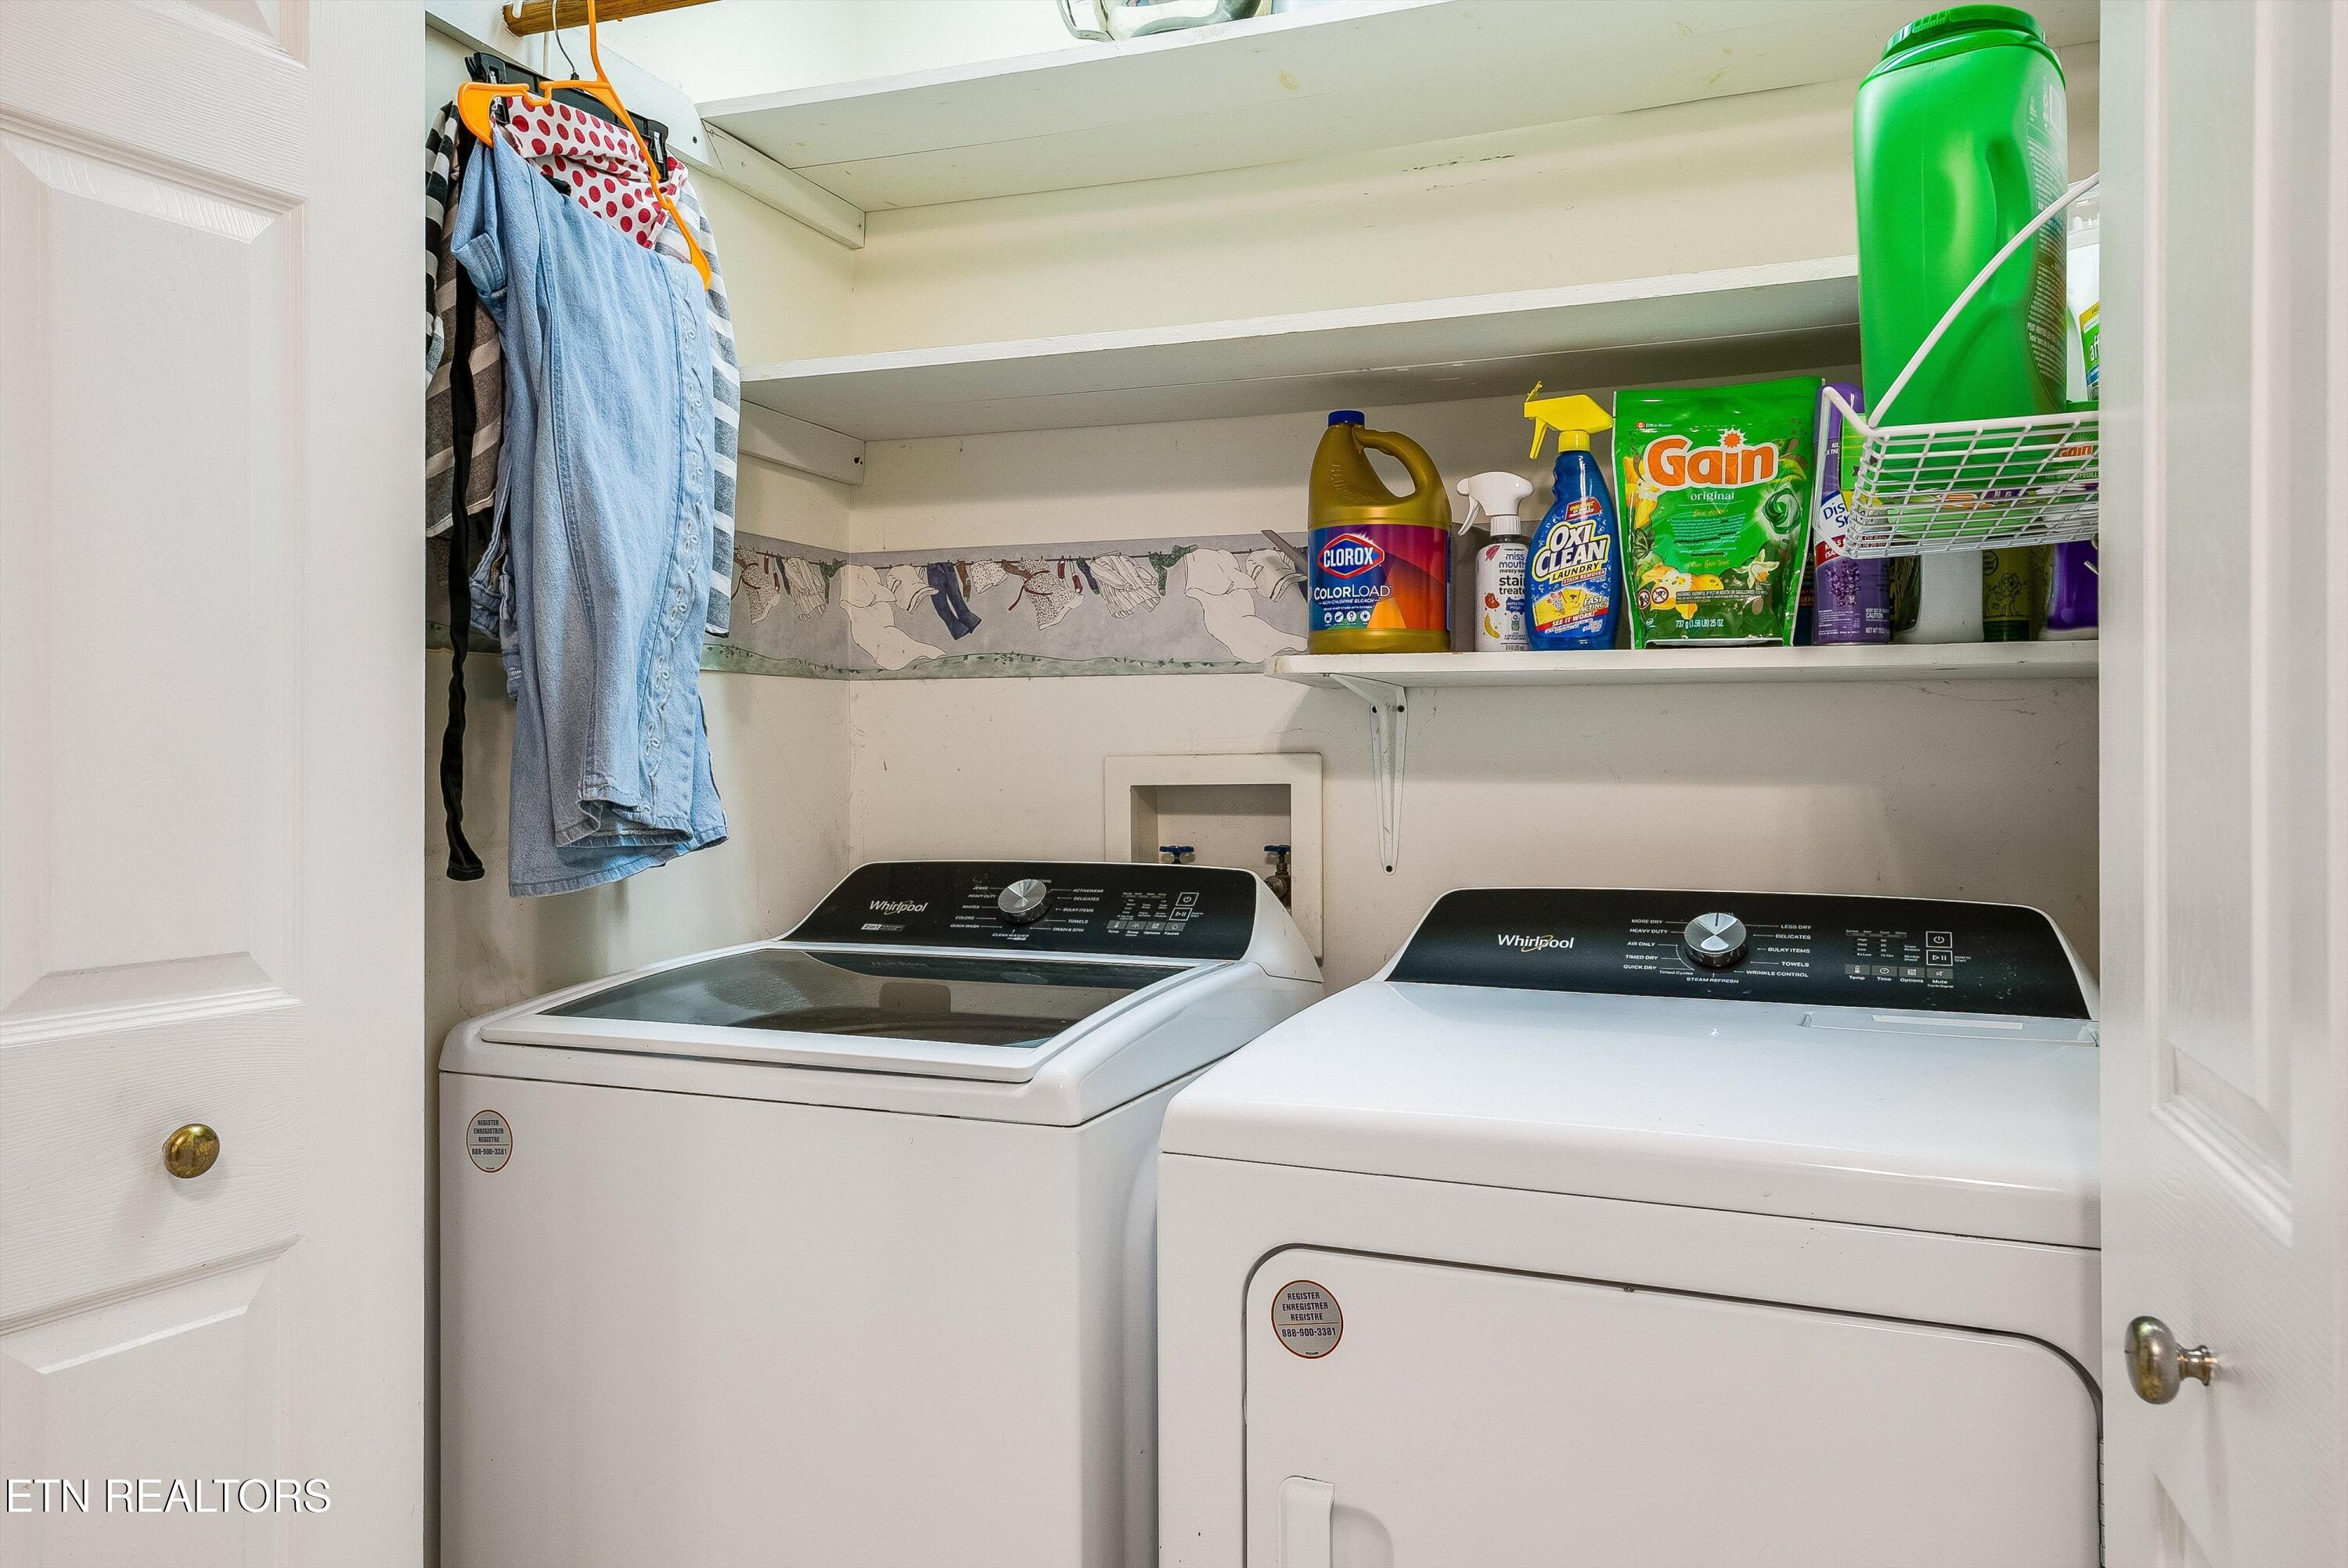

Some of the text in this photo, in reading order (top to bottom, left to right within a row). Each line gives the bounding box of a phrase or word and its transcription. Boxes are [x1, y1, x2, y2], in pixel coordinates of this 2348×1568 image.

[1647, 431, 1775, 487] Gain
[1690, 491, 1735, 502] original
[1550, 523, 1593, 552] OXI
[1323, 547, 1374, 567] CLOROX
[1506, 552, 1525, 561] miss
[1535, 538, 1608, 577] CLEAN
[1552, 562, 1600, 581] LAUNDRY
[1562, 574, 1579, 585] STAIN
[1580, 570, 1605, 581] REMOVER
[1314, 584, 1391, 601] COLORLOAD
[1584, 595, 1603, 606] FAST
[1717, 619, 1724, 628] OZ
[869, 900, 929, 915] Whirlpool
[1497, 934, 1575, 951] Whirlpool
[1287, 1292, 1320, 1300] REGISTER
[1282, 1301, 1328, 1311] ENREGISTRER
[1291, 1312, 1323, 1322] REGISTRE
[1282, 1327, 1336, 1337] 888-900-3381
